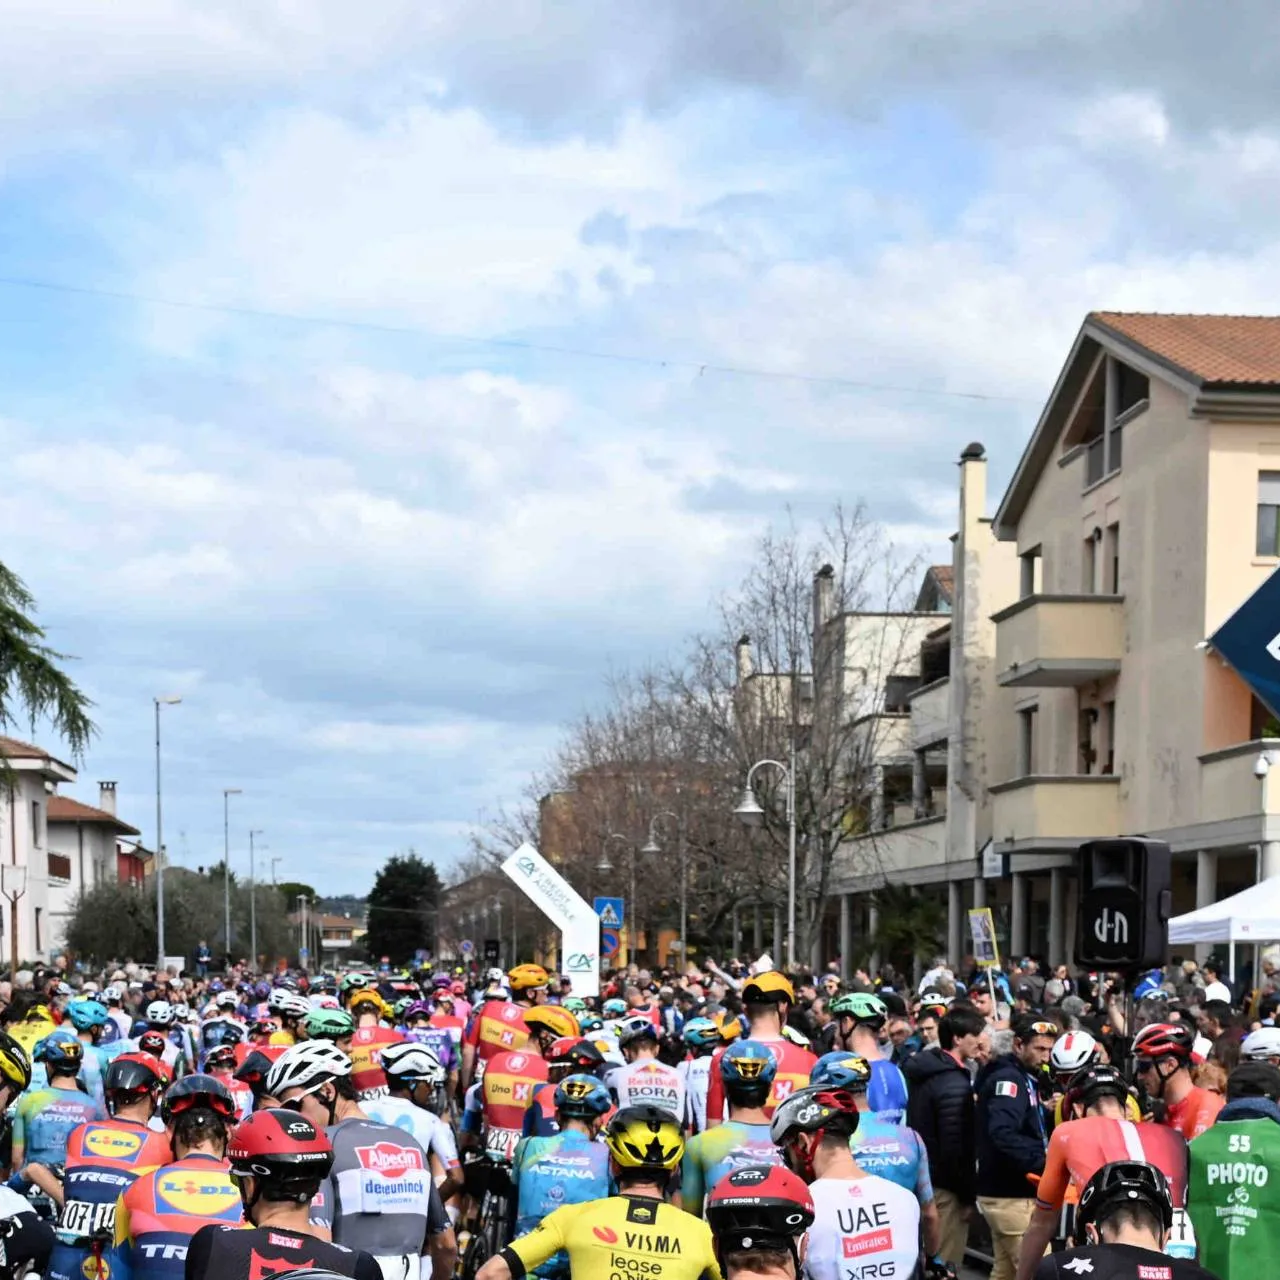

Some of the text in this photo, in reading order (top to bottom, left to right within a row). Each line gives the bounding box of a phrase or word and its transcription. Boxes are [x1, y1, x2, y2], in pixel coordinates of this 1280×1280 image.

[628, 1087, 678, 1100] BORA
[35, 1112, 87, 1124] ASTANA
[1228, 1134, 1251, 1153] 55
[368, 1149, 417, 1168] Alpecin
[528, 1166, 595, 1180] ASTANA
[1206, 1162, 1269, 1187] PHOTO
[837, 1203, 890, 1234] UAE
[140, 1243, 189, 1261] TR
[624, 1231, 682, 1254] VISMA
[846, 1237, 889, 1253] Emirates
[610, 1252, 663, 1275] lease
